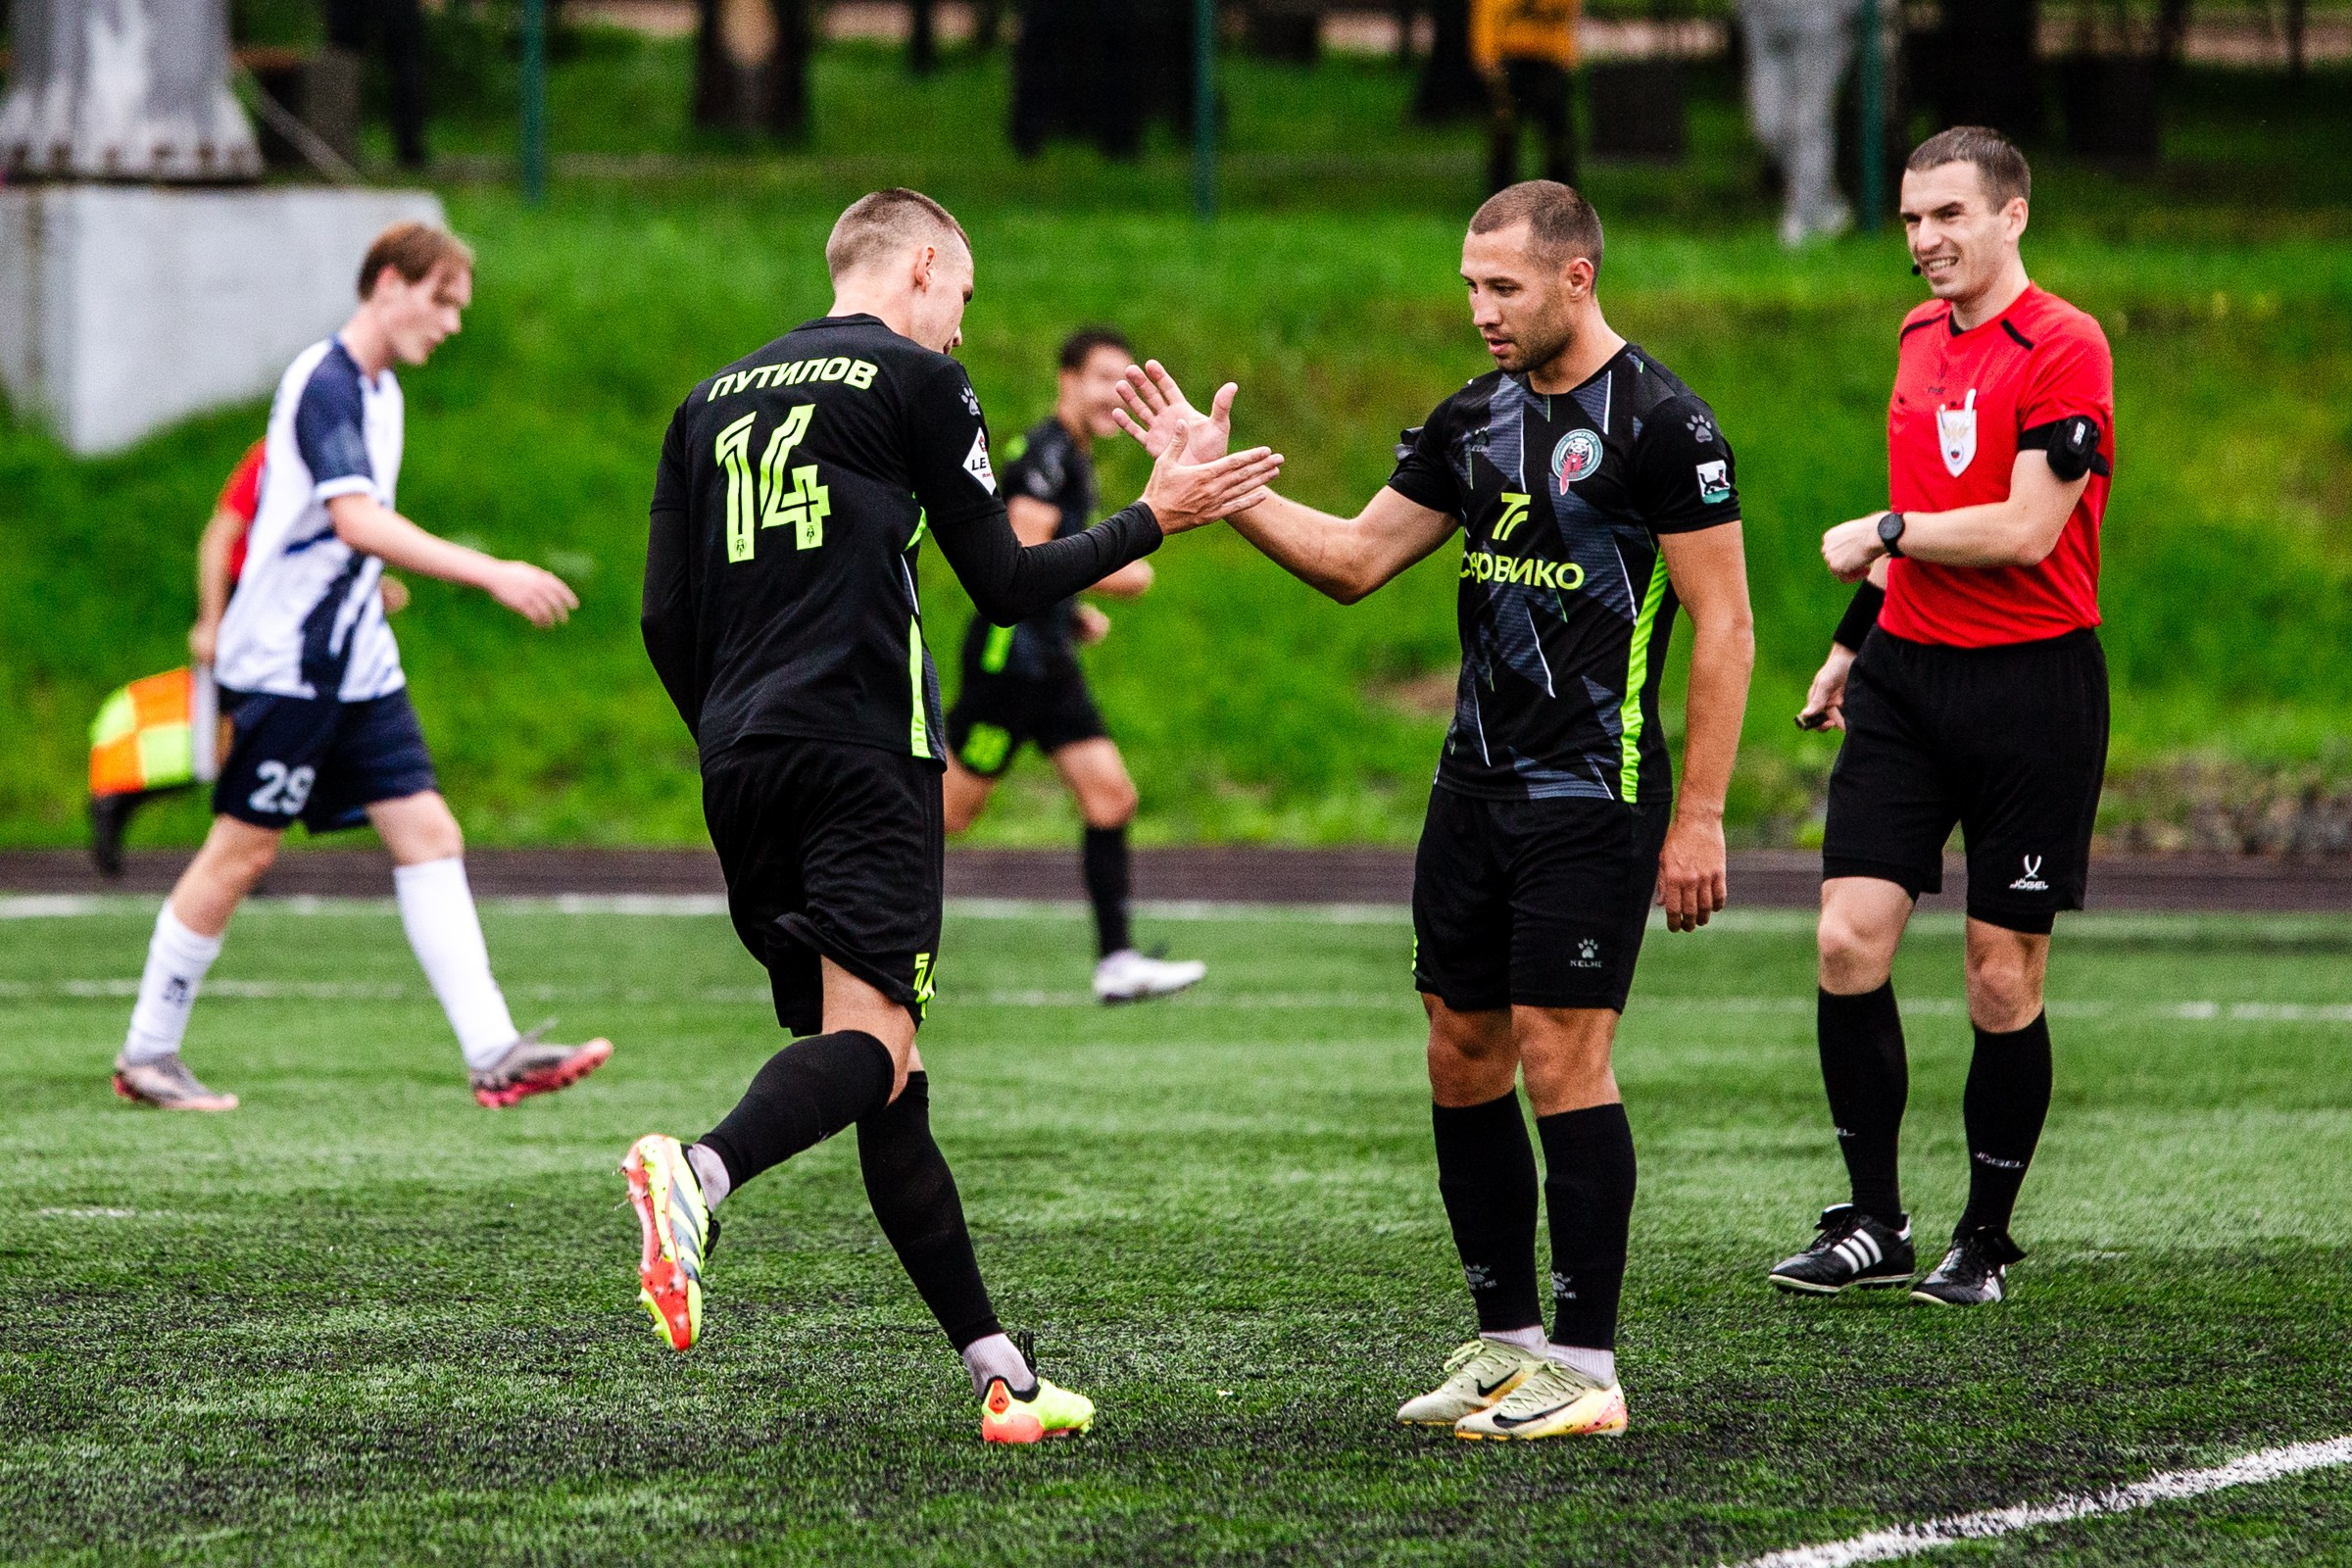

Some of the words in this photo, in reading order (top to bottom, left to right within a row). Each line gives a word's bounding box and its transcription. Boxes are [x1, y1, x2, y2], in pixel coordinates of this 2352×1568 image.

[707, 357, 878, 402] ПУТИЛОВ
[715, 403, 831, 564] 14
[248, 760, 316, 815] 29
